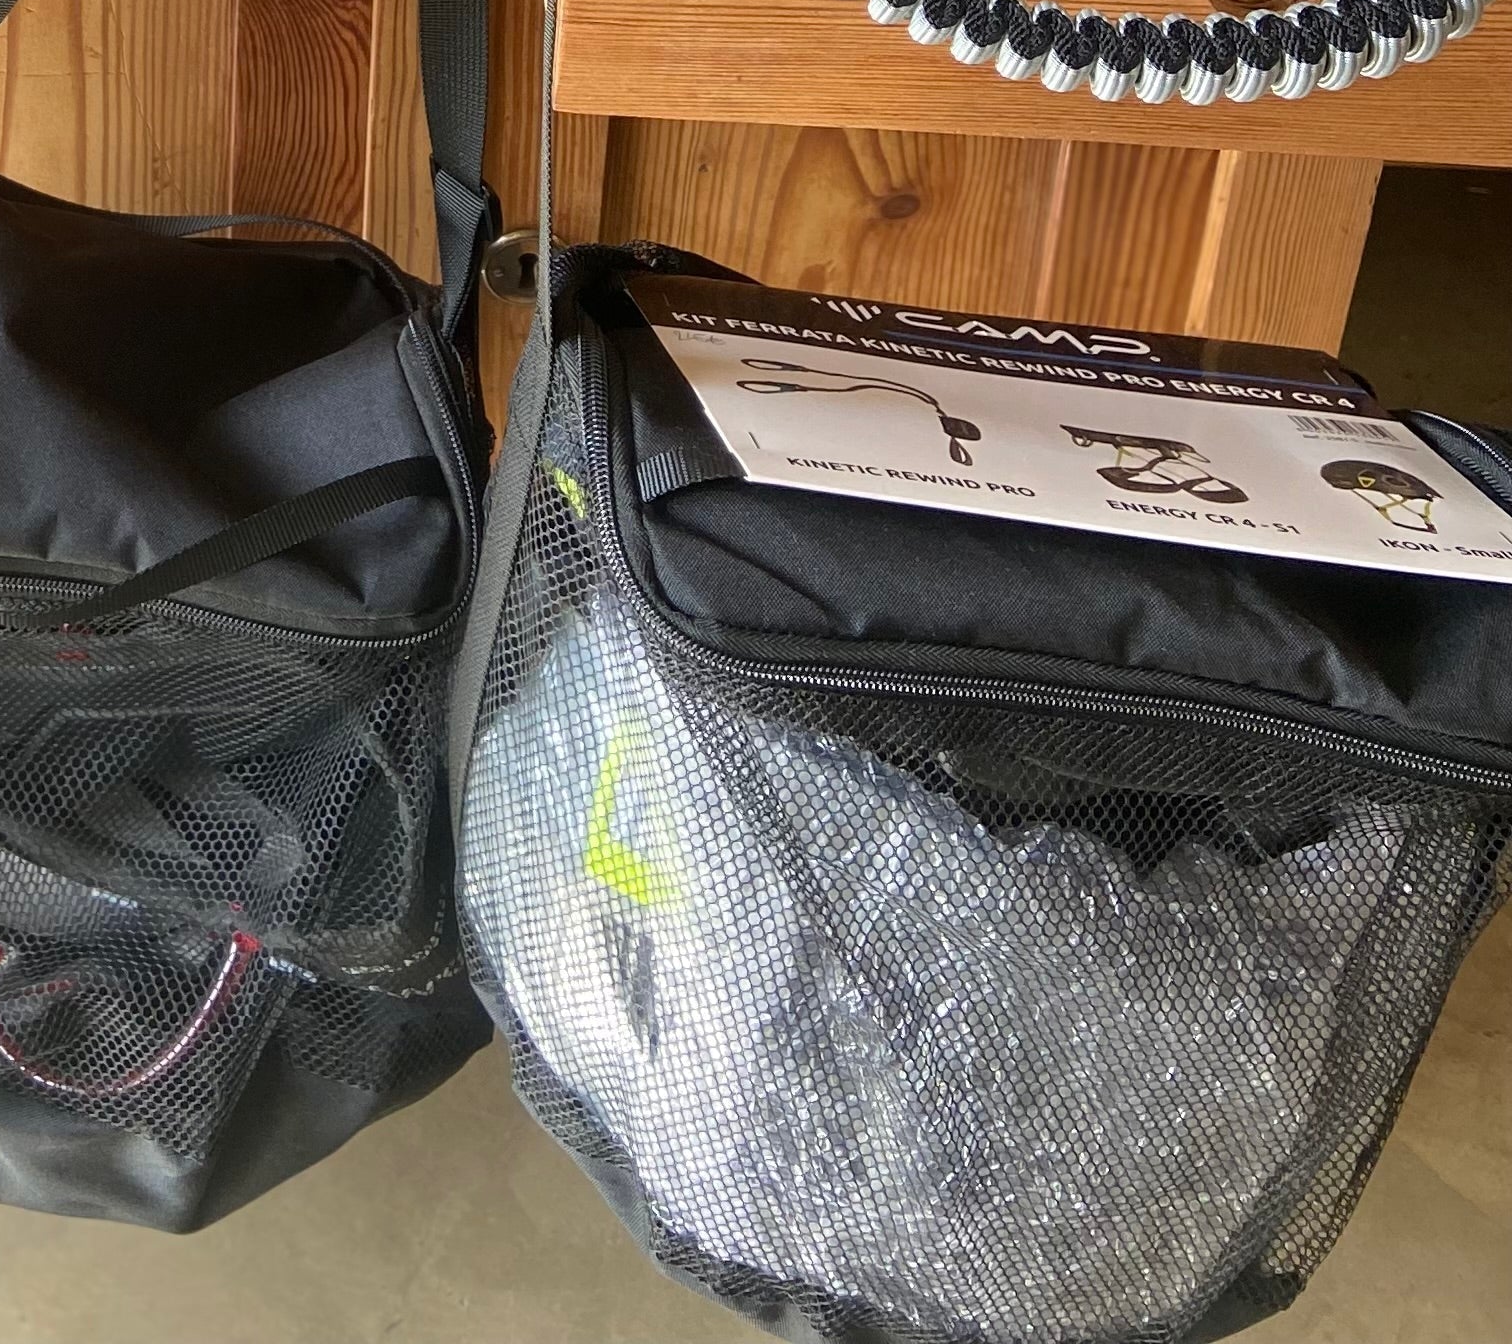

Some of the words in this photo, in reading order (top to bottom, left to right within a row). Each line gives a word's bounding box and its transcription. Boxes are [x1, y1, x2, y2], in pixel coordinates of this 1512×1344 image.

[672, 311, 717, 327] KIT
[725, 318, 853, 346] FERRATA
[860, 336, 977, 366] KINETIC
[982, 356, 1099, 382] REWIND
[1103, 370, 1165, 390] PRO
[1170, 379, 1288, 402] ENERGY
[1291, 391, 1333, 407] CR
[1338, 398, 1356, 410] 4
[786, 457, 883, 477] KINETIC
[886, 469, 981, 490] REWIND
[986, 482, 1037, 498] PRO
[1106, 499, 1197, 521] ENERGY
[1204, 513, 1239, 527] CR
[1242, 519, 1256, 529] 4
[1273, 522, 1301, 535] S1
[1378, 537, 1440, 553] IKON
